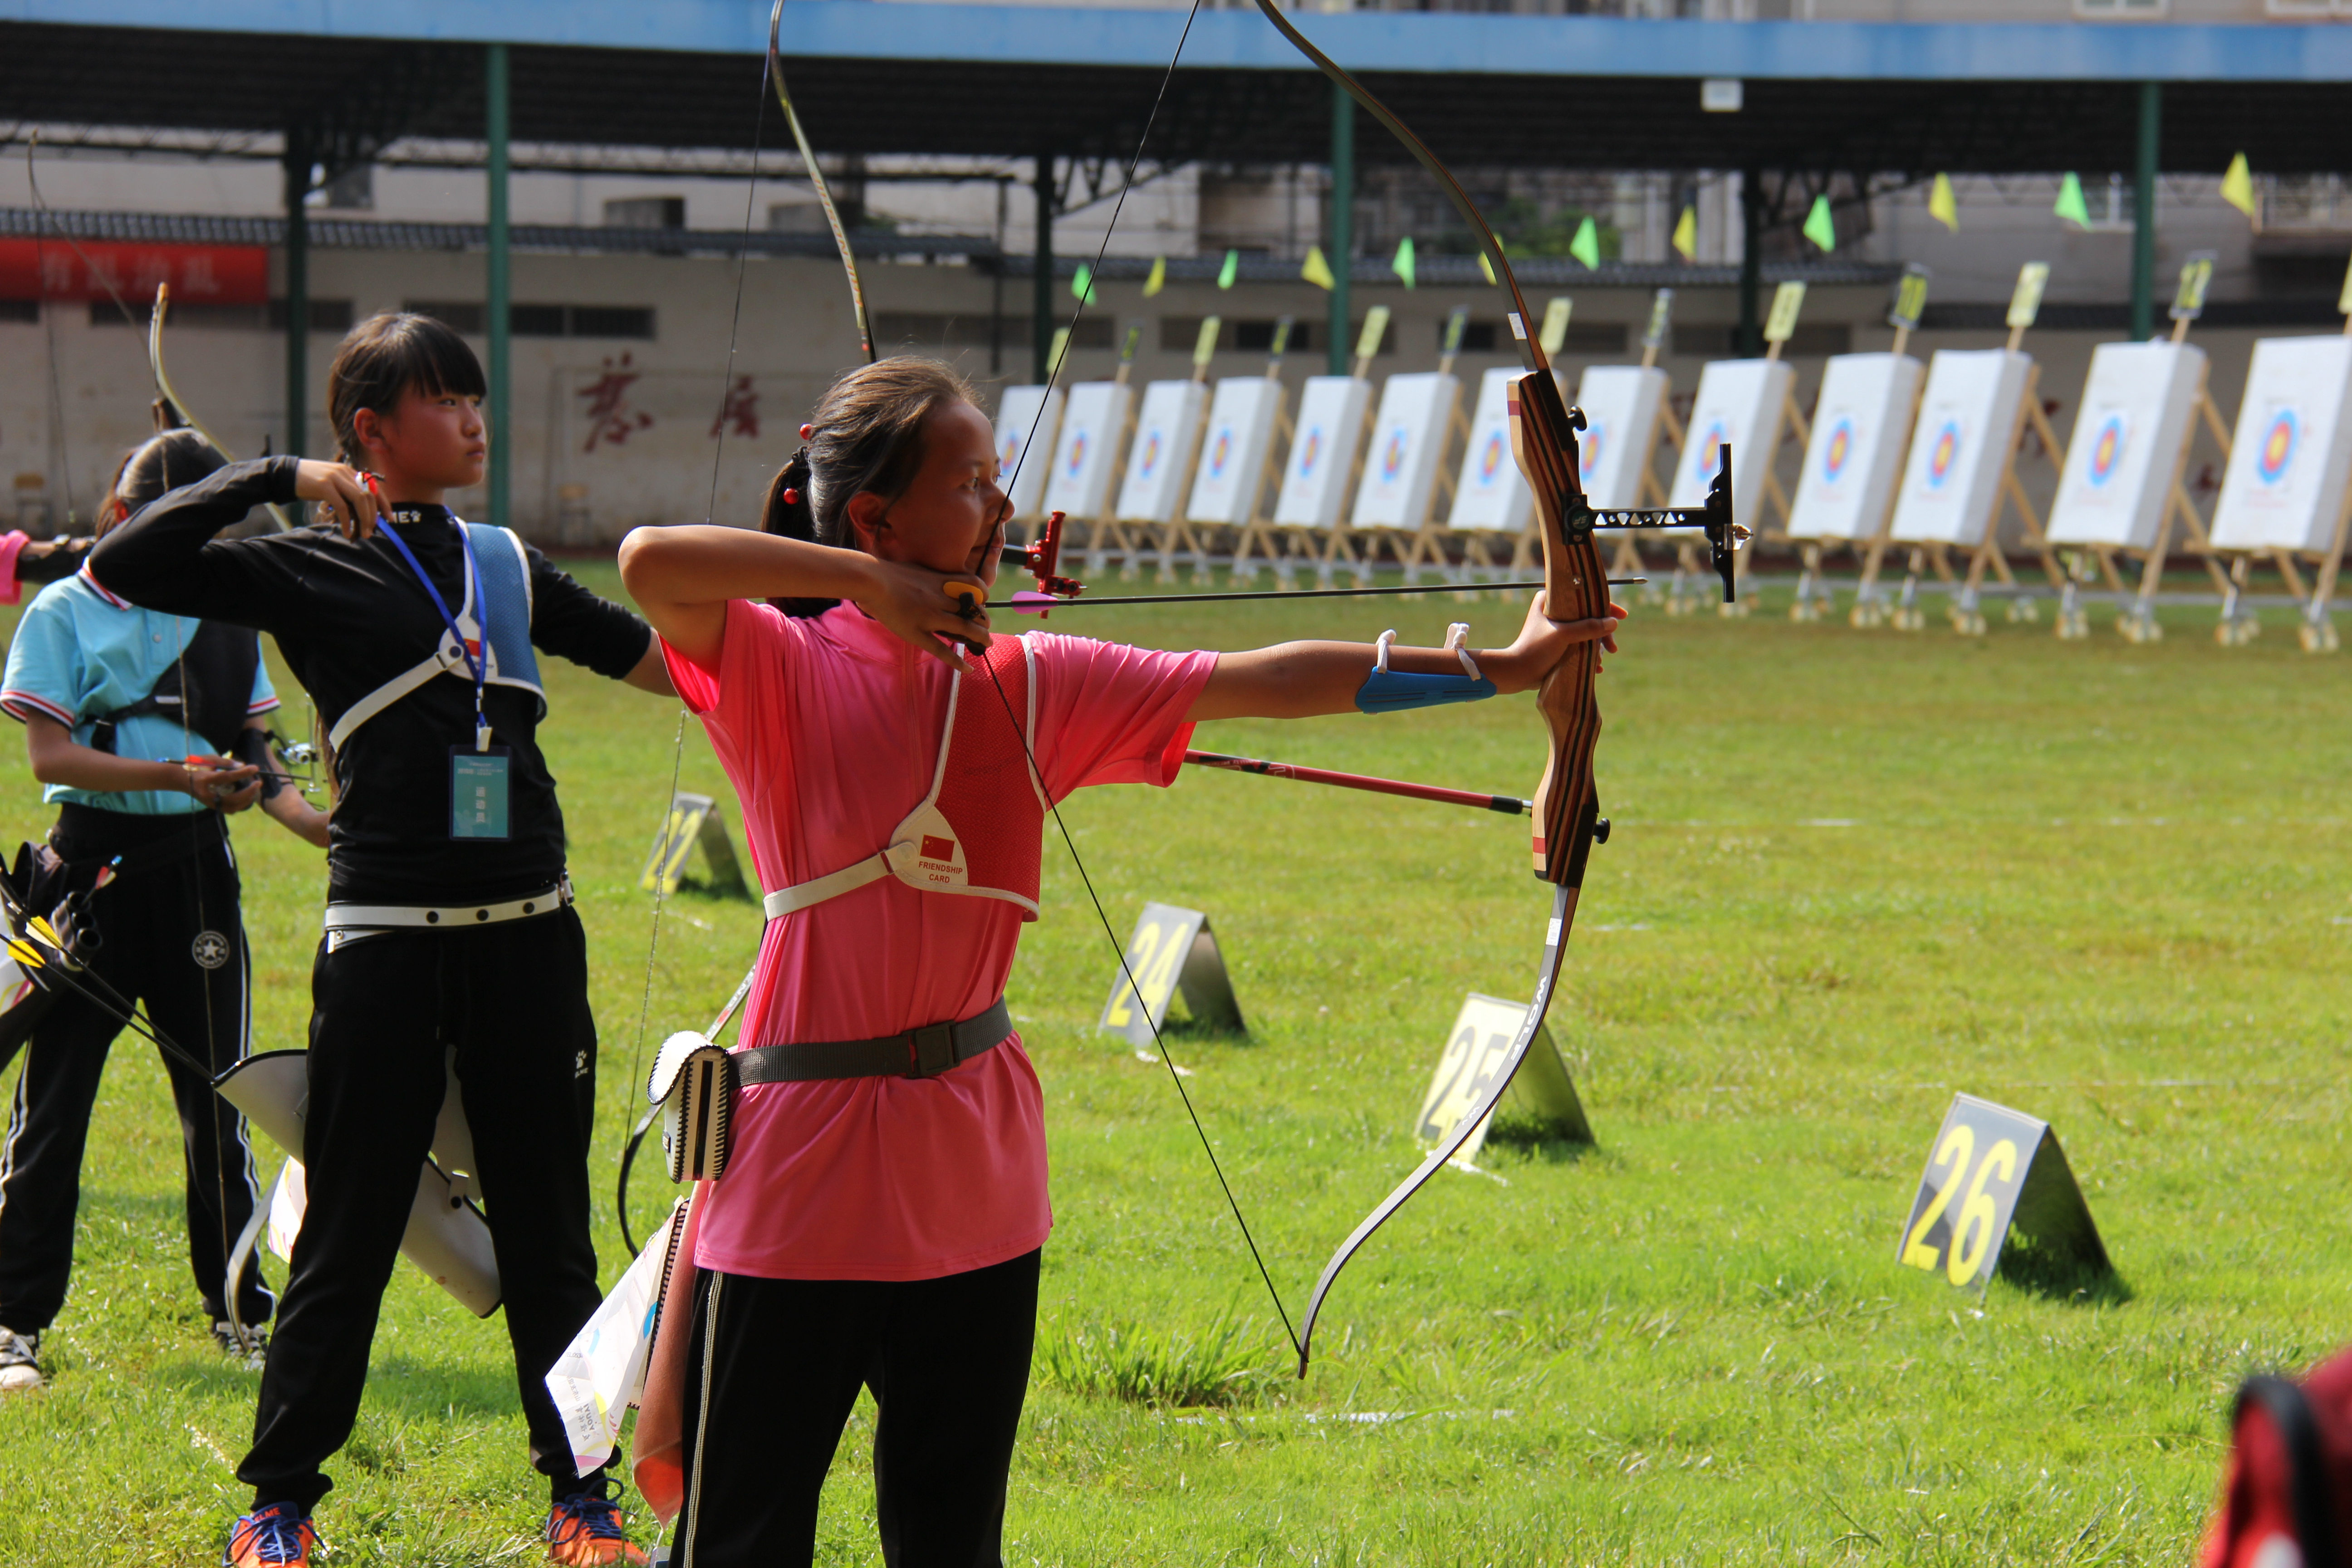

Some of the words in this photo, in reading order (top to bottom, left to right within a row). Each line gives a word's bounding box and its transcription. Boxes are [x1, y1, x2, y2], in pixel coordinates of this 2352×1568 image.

[919, 861, 963, 875] FRIENDSHIP
[929, 874, 950, 883] CARD
[1106, 921, 1190, 1028] 24
[1510, 976, 1548, 1061] WOLF
[1901, 1125, 2017, 1286] 26
